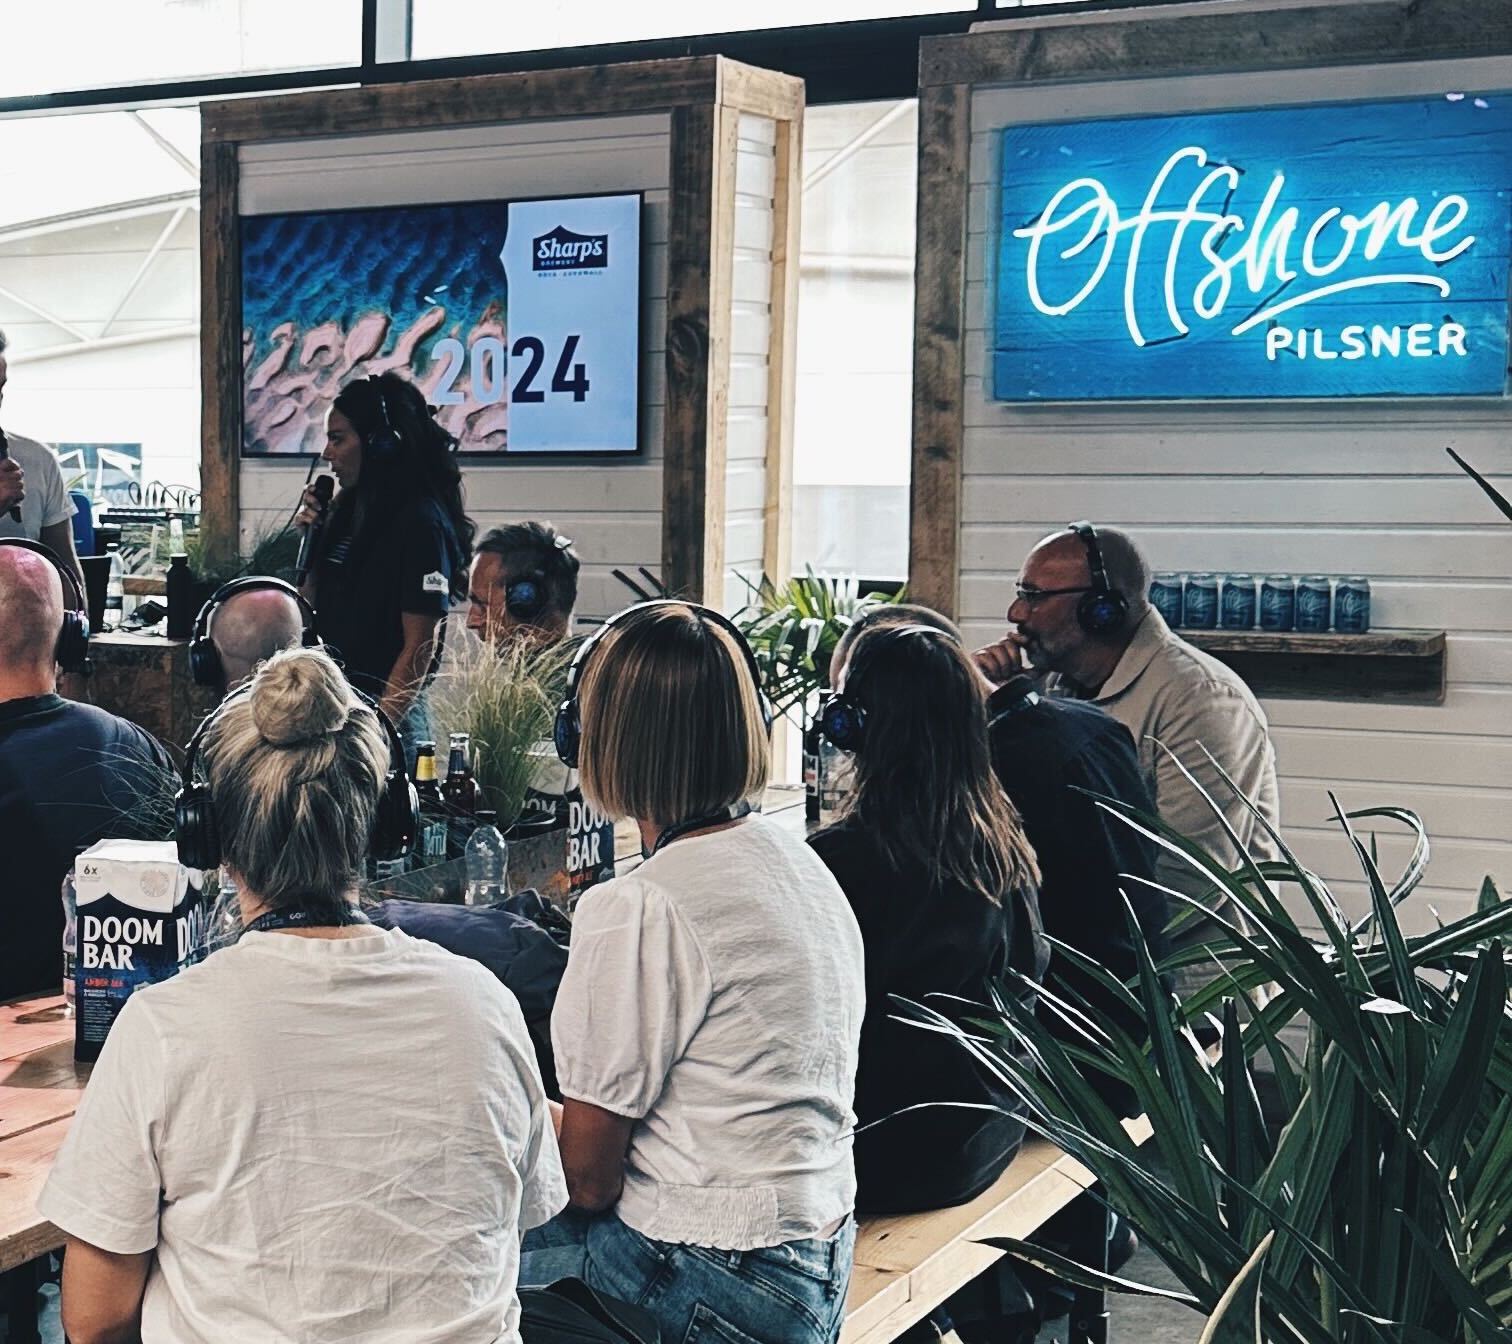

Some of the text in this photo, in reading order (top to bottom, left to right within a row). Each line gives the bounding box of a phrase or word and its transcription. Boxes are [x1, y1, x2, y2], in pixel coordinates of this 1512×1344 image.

[537, 238, 603, 262] Sharp's
[1014, 146, 1476, 347] Offshore
[1266, 322, 1467, 361] PILSNER
[431, 334, 590, 405] 2024
[570, 832, 601, 873] BAR
[83, 916, 164, 946] DOOM
[83, 942, 136, 971] BAR
